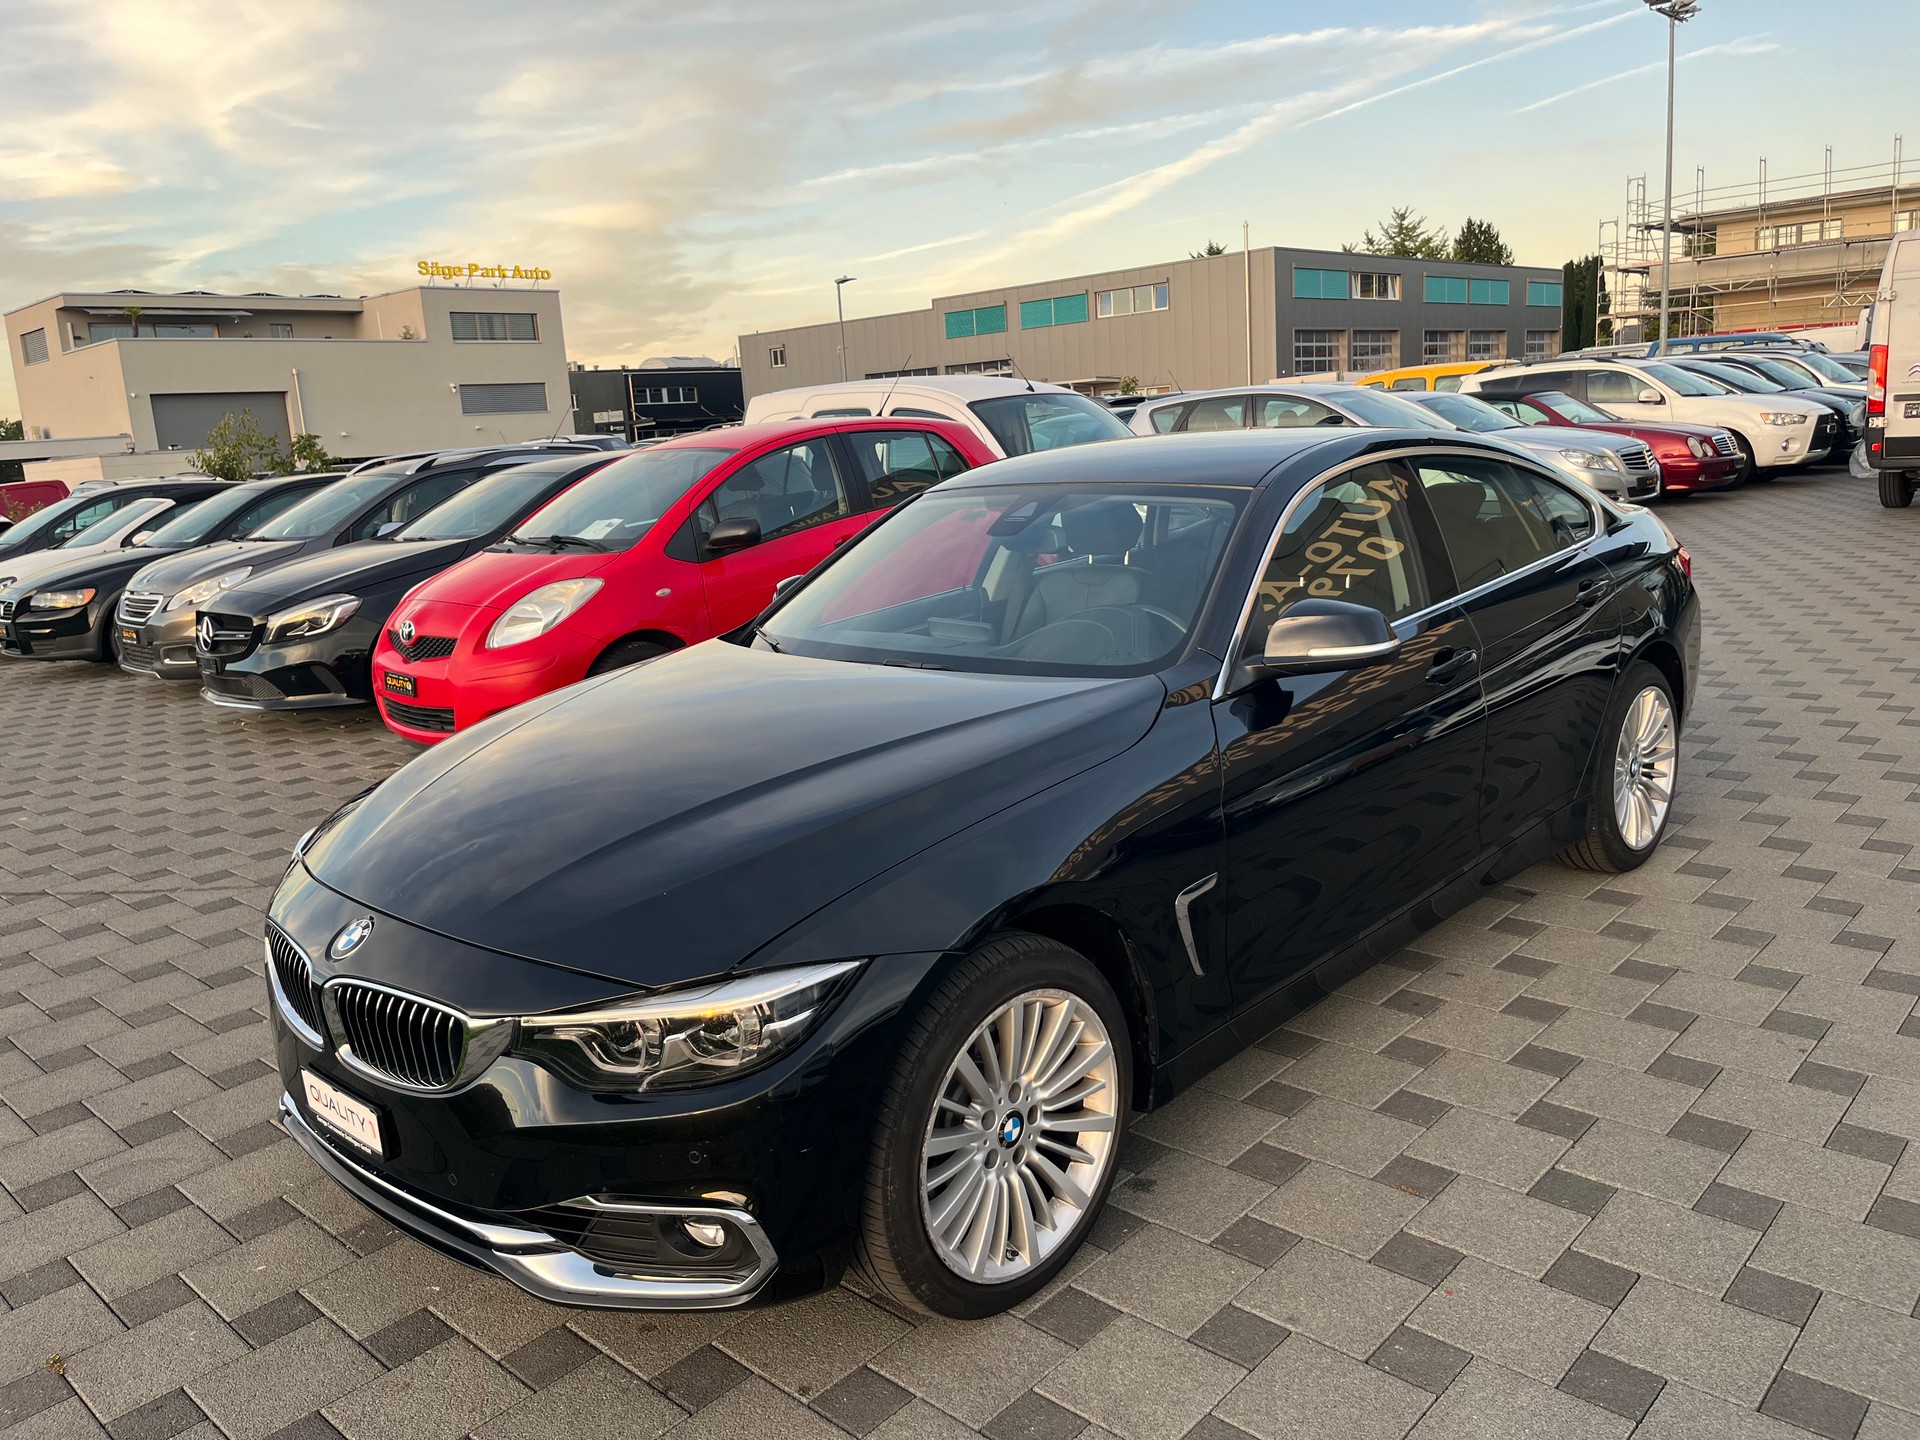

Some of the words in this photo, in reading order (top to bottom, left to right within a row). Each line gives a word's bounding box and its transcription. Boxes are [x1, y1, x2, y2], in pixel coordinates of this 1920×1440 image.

[417, 260, 463, 280] Säge
[468, 263, 507, 278] Park
[512, 265, 552, 280] Auto
[309, 1084, 365, 1132] QUALITY
